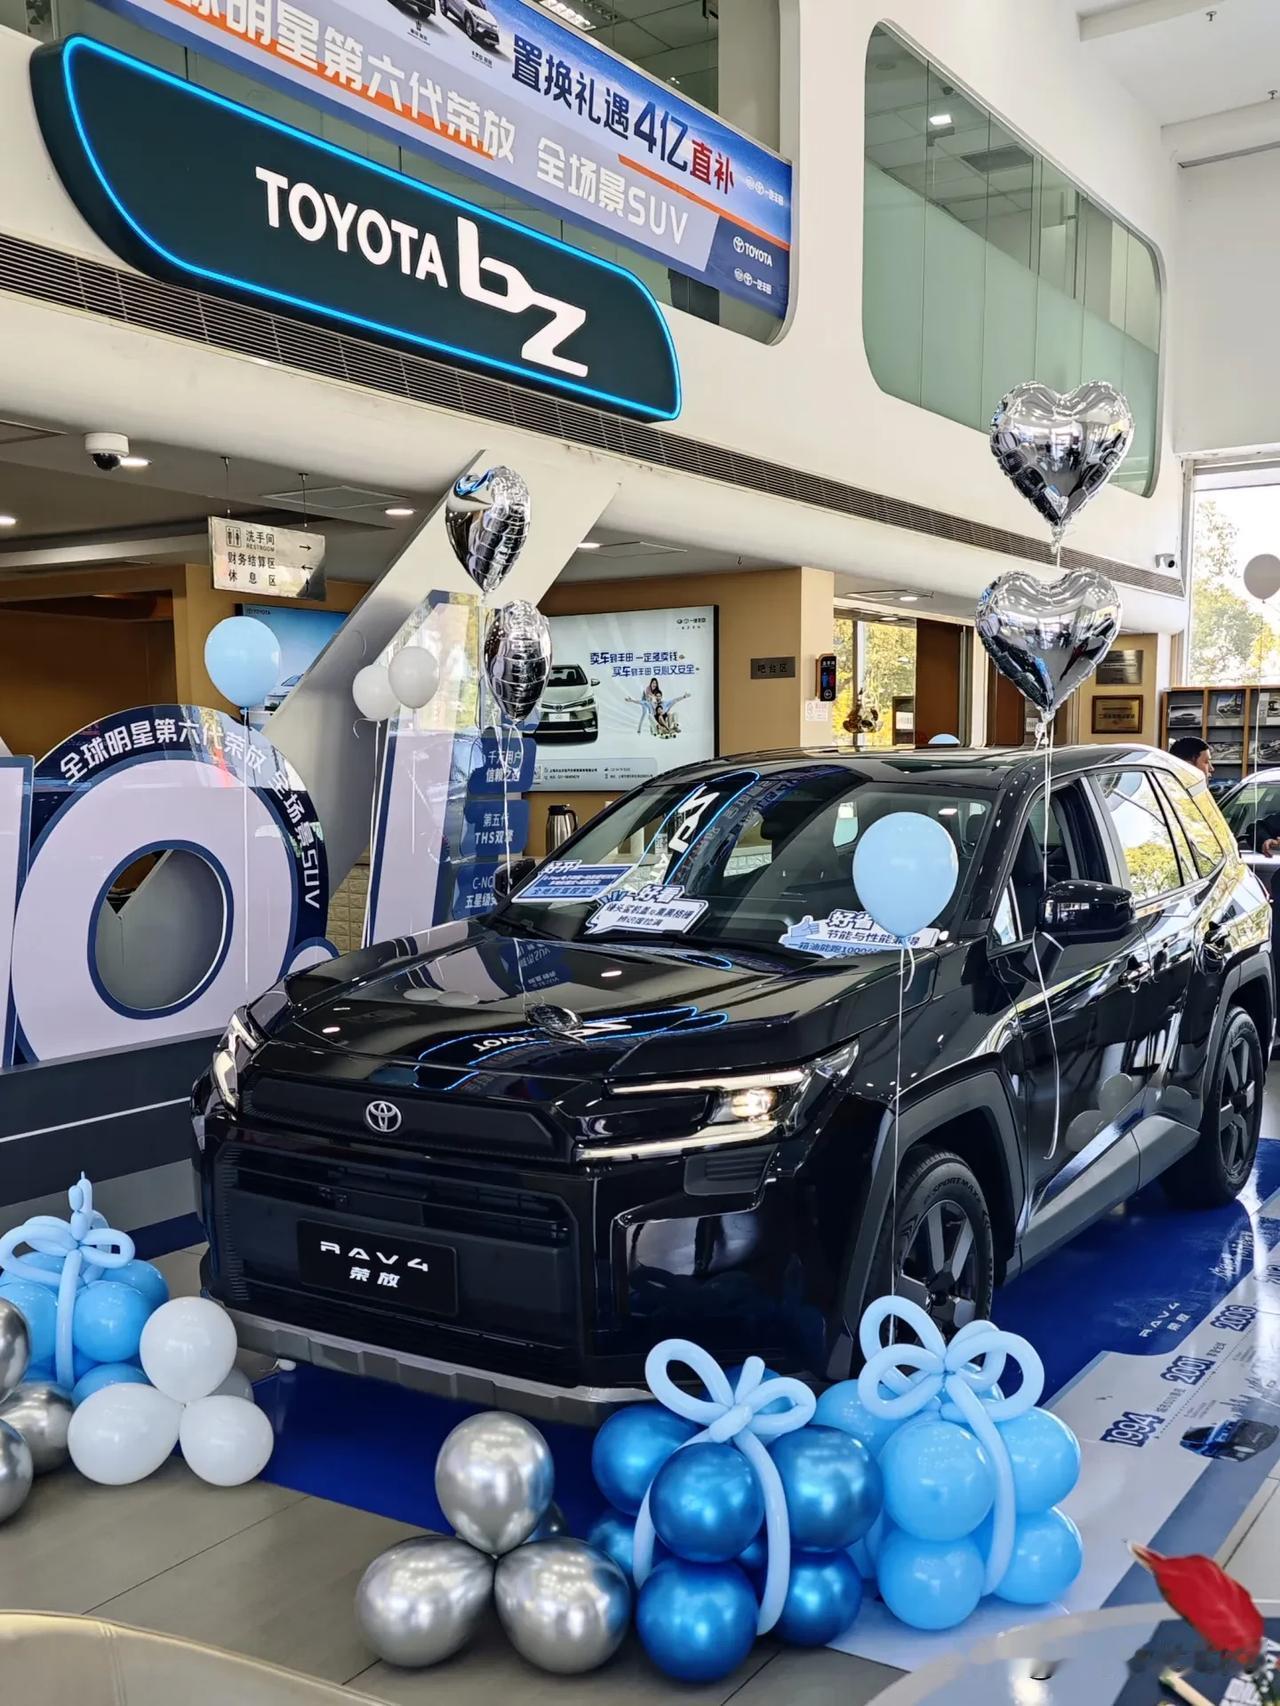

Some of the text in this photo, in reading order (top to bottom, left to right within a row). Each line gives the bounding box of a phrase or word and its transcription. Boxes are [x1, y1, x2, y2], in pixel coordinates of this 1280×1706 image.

[512, 34, 734, 195] 置换礼遇4亿直补
[537, 137, 688, 244] 全场景SUV
[256, 166, 448, 288] TOYOTA
[744, 243, 773, 267] TOYOTA
[246, 529, 275, 546] 洗手间
[228, 552, 275, 569] 财务结算区
[757, 663, 788, 674] 吧台区
[59, 718, 320, 909] 全球明星第六代荣放 全场景SUV
[320, 1240, 429, 1272] RAV4
[350, 1267, 400, 1288] 荣放
[1139, 1302, 1180, 1337] RAV4
[1210, 1305, 1258, 1332] 2006
[1160, 1355, 1216, 1386] 2001
[1100, 1411, 1165, 1447] 1994
